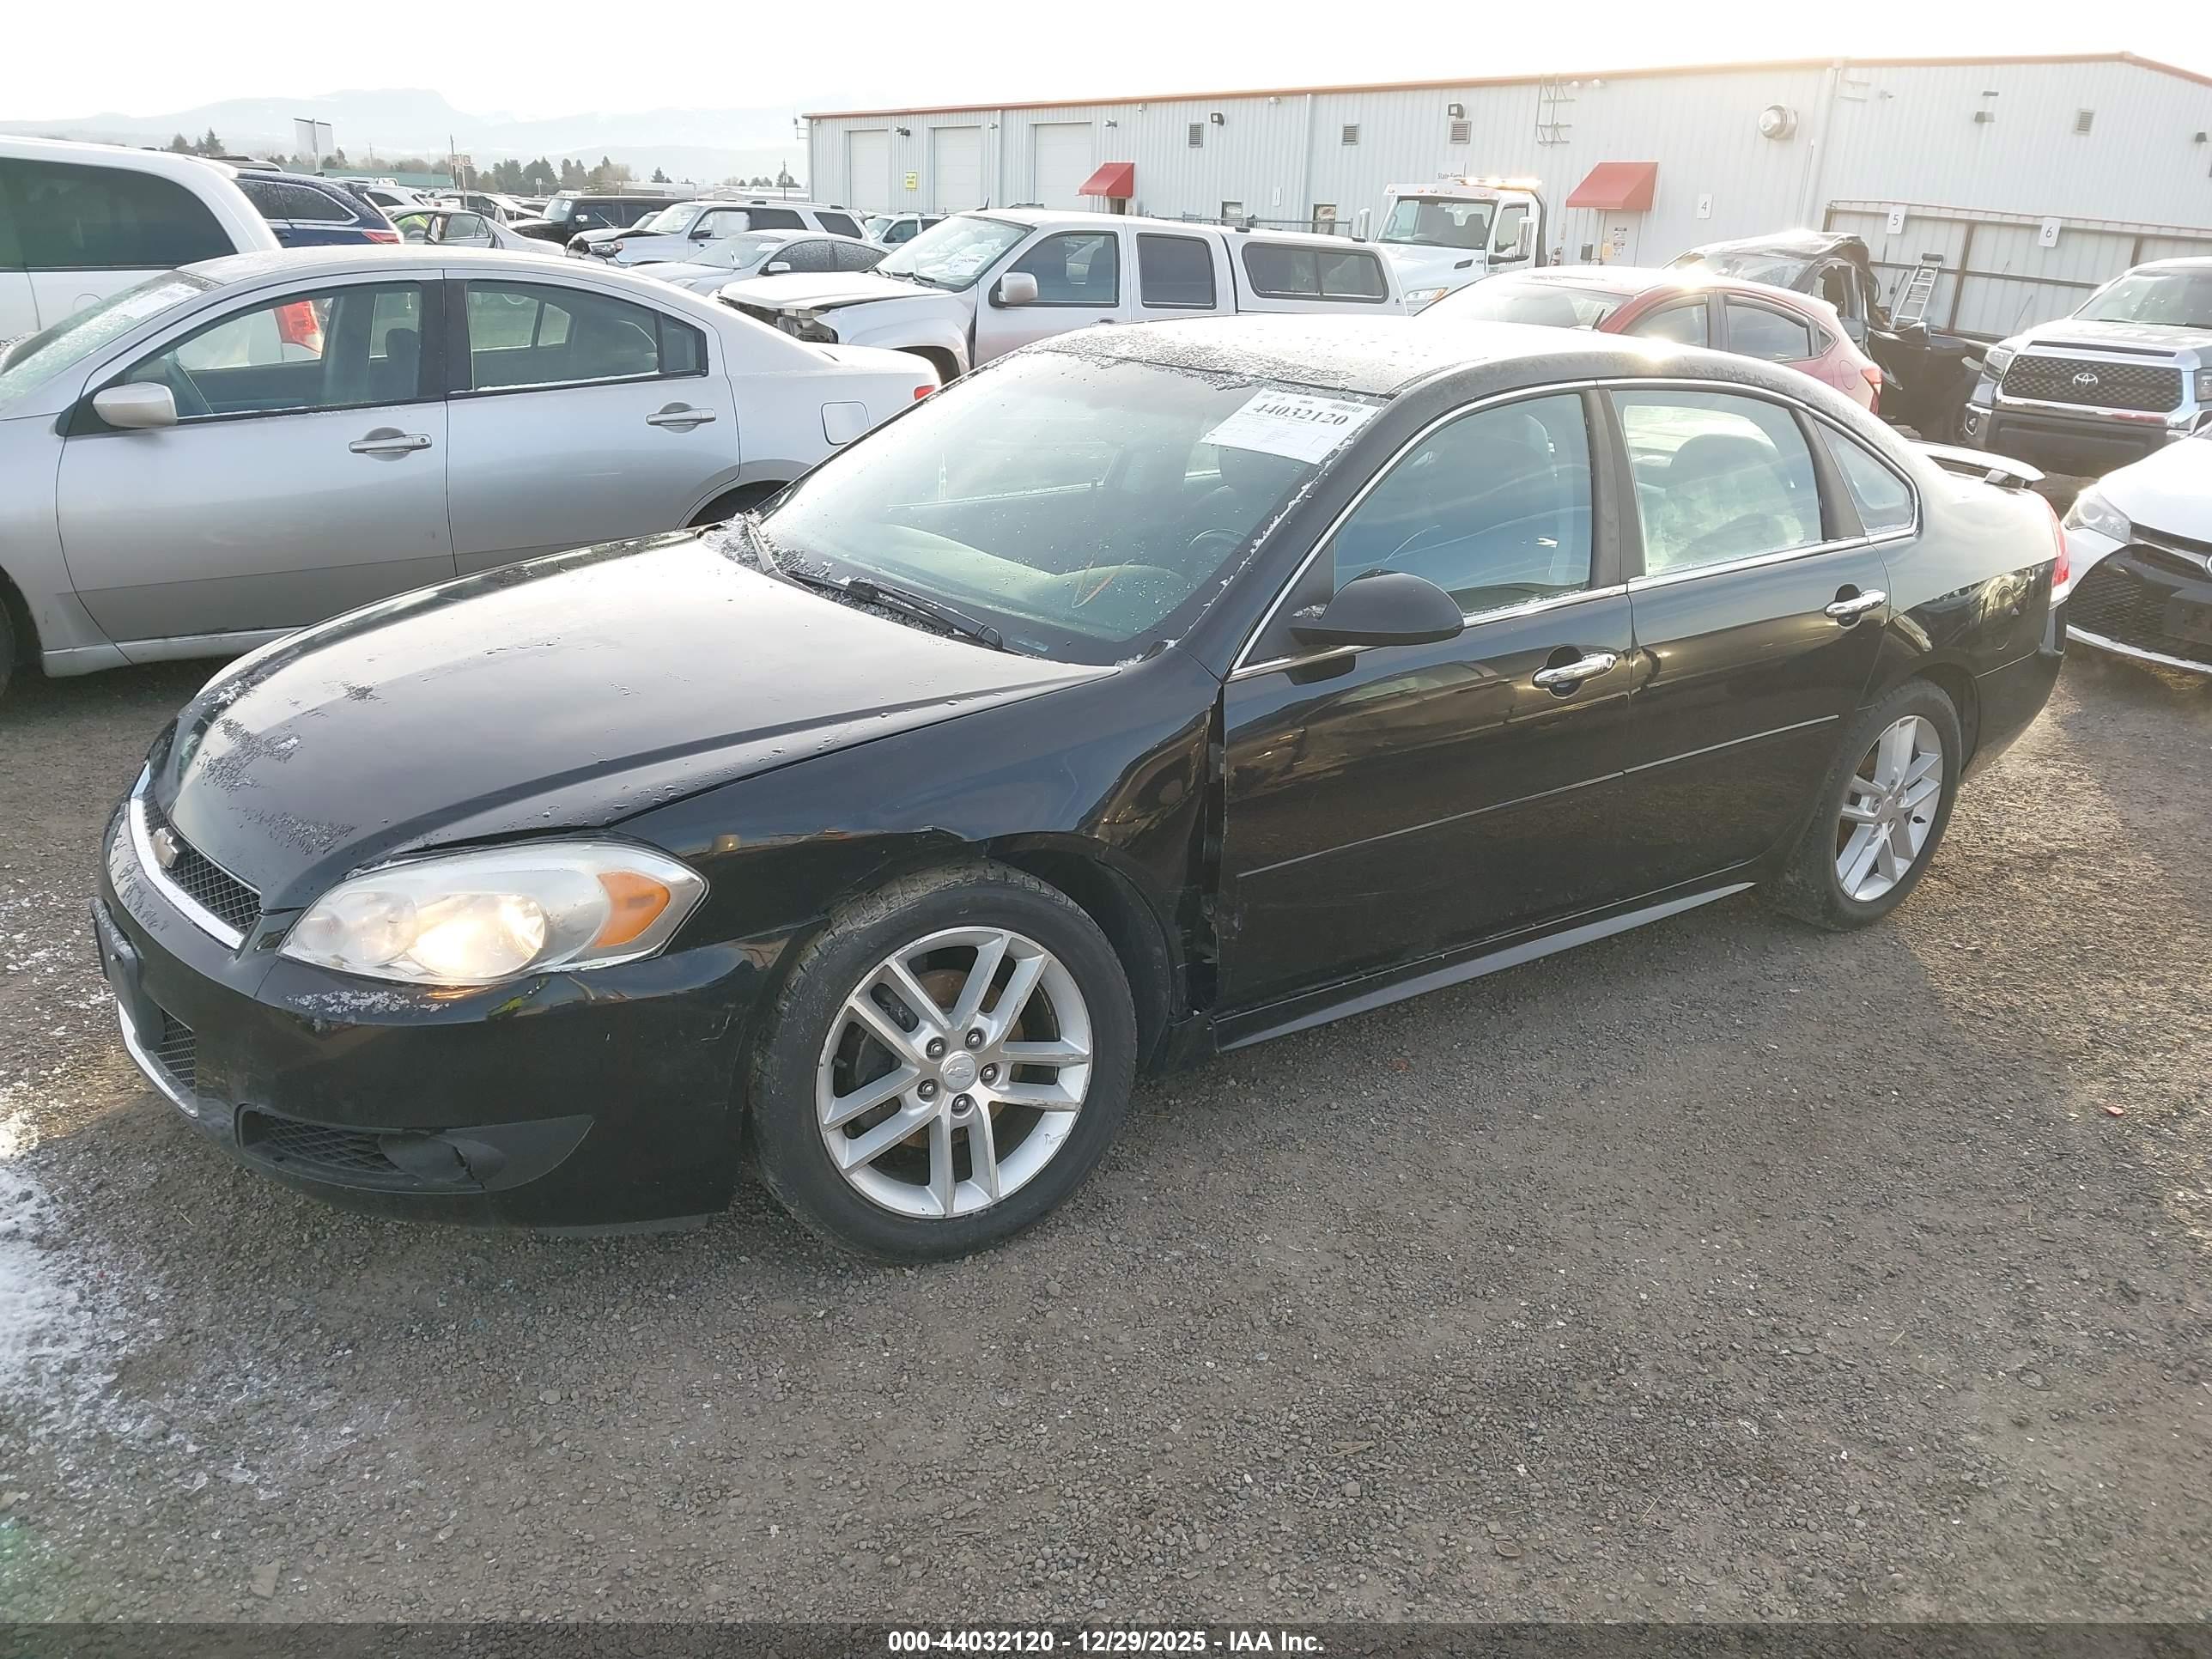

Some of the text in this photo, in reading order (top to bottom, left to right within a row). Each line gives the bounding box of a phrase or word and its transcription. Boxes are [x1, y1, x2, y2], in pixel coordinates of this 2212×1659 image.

[1701, 201, 1707, 212] 4
[1892, 213, 1899, 226] 5
[2045, 226, 2053, 238] 6
[1253, 403, 1349, 425] 44032120
